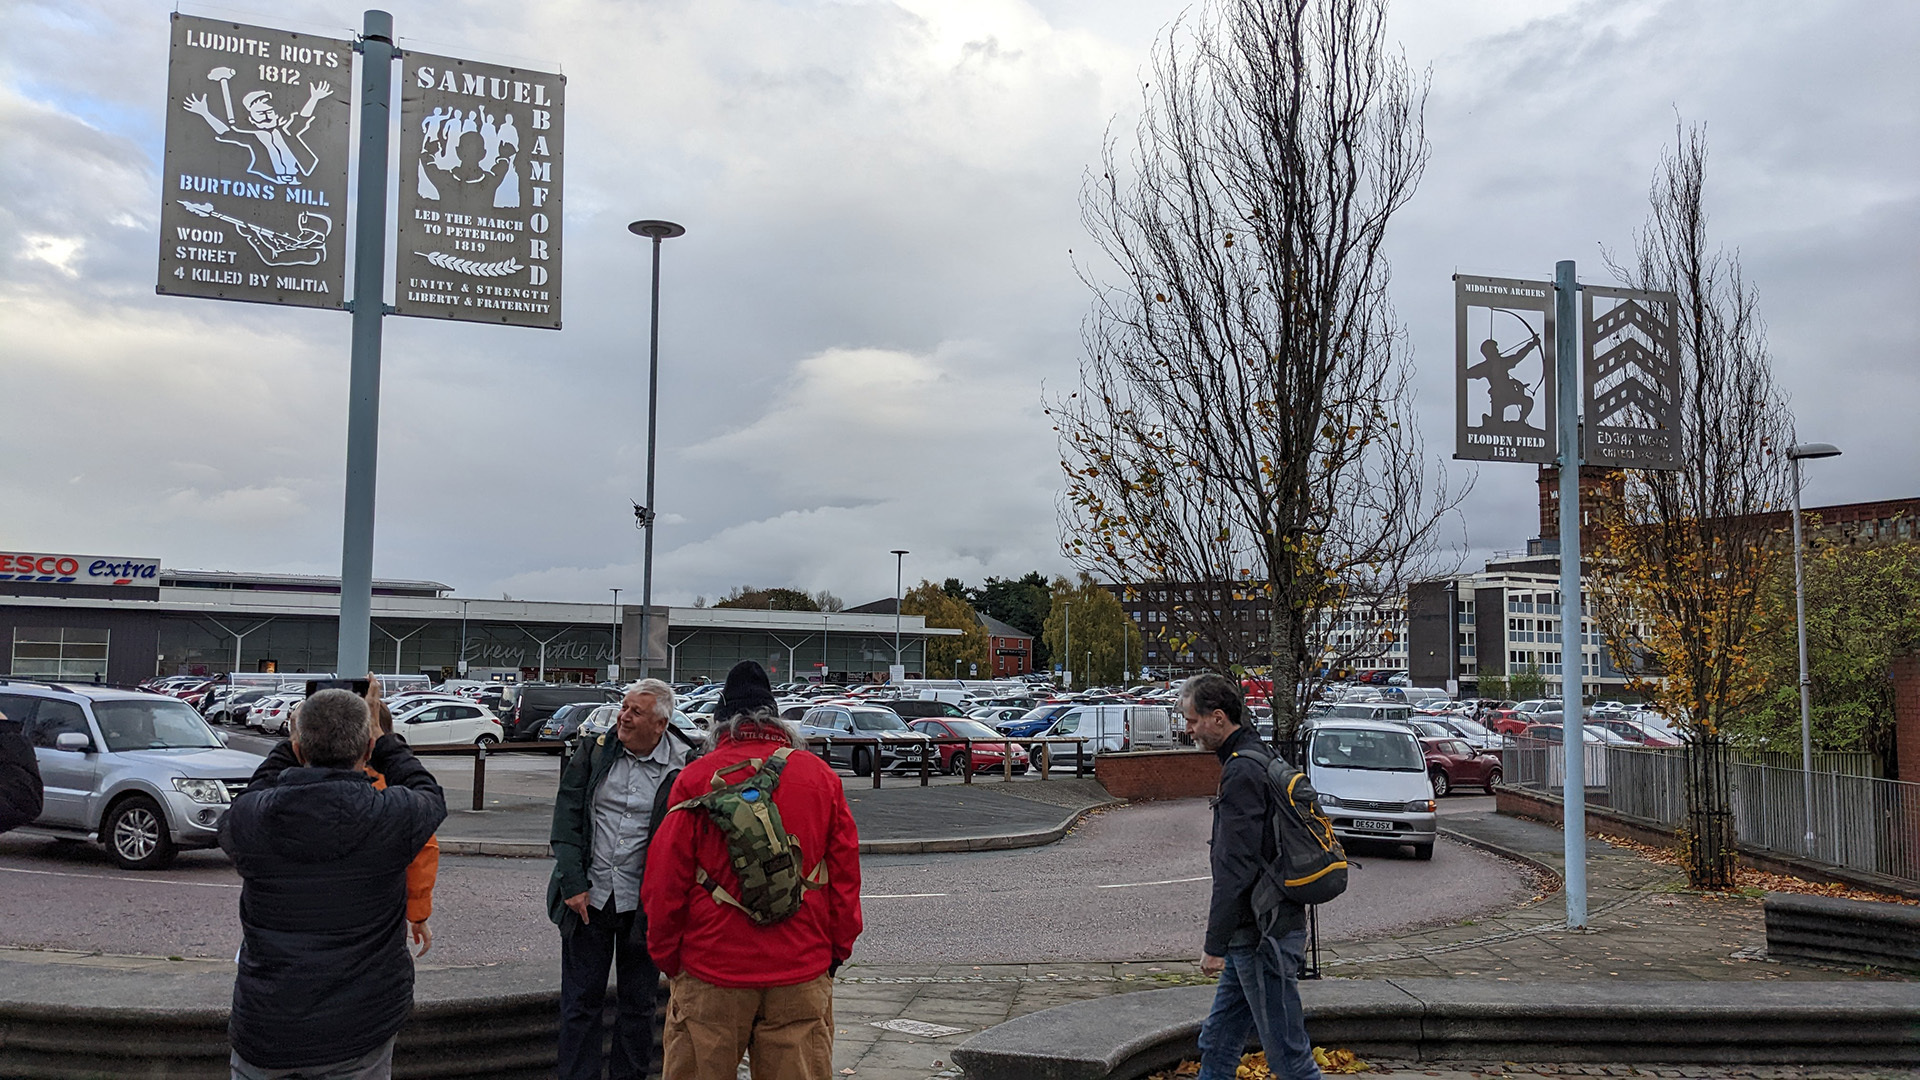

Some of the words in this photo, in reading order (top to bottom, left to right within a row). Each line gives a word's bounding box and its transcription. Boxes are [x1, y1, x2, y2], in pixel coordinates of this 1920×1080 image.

[187, 30, 270, 58] LUDDITE
[280, 44, 338, 68] RIOTS
[258, 64, 301, 85] 1812
[417, 66, 551, 107] SAMUEL
[180, 174, 275, 200] BURTONS
[286, 187, 329, 207] MILL
[529, 109, 552, 286] BAMFORD
[415, 209, 440, 221] LED
[445, 213, 472, 226] THE
[477, 217, 524, 231] MARCH
[176, 227, 224, 244] WOOD
[424, 224, 442, 235] TO
[446, 226, 515, 243] PETERLOO
[175, 246, 237, 264] STREET
[454, 240, 486, 253] 1819
[174, 266, 185, 280] 4
[192, 268, 242, 285] KILLED
[249, 273, 270, 288] BY
[276, 276, 329, 293] MILITIA
[410, 278, 454, 292] UNITY
[461, 284, 471, 293] &
[476, 284, 550, 301] STRENGTH
[1465, 283, 1508, 295] MIDDLETON
[1510, 287, 1546, 298] ARCHERS
[408, 291, 461, 306] LIBERTY
[464, 297, 473, 306] &
[476, 298, 550, 315] FRATERNITY
[1467, 433, 1513, 447] FLODDEN
[1516, 436, 1546, 448] FIELD
[1493, 446, 1517, 458] 1513
[88, 559, 157, 579] extra
